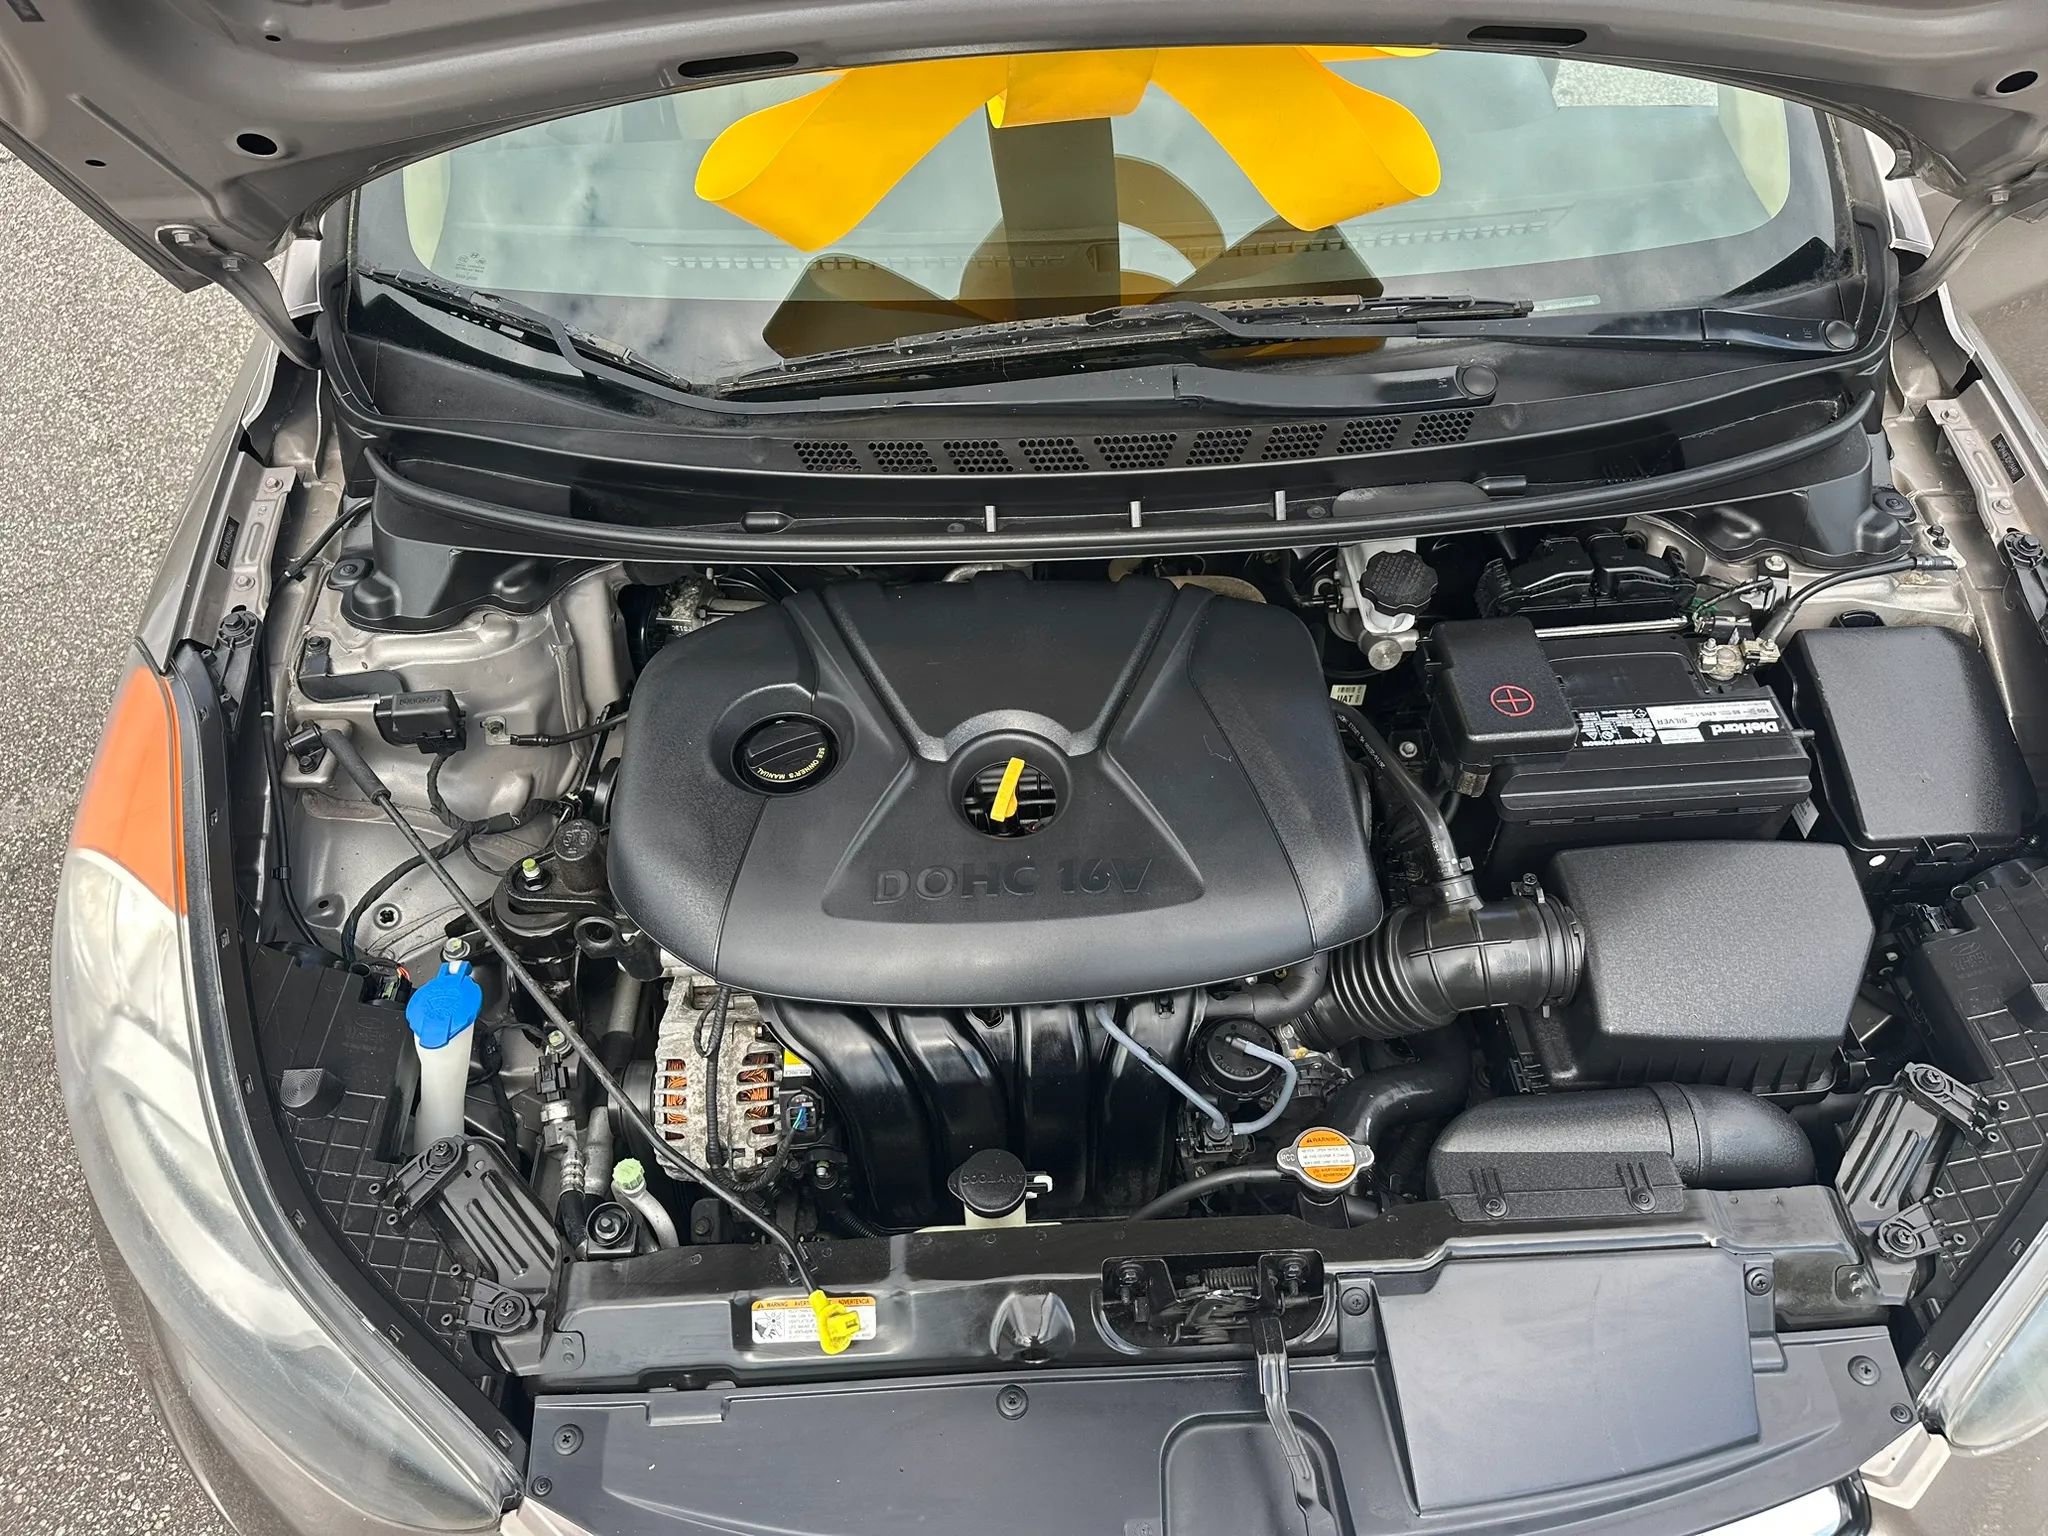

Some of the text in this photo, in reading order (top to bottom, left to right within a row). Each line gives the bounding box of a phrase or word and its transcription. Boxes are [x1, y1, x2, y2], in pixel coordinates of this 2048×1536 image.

[1656, 717, 1688, 726] SILVER
[1709, 720, 1779, 737] DieHard
[756, 747, 825, 780] SEE OWNER'S MANUAL
[872, 857, 1153, 904] DOHC 16V
[961, 1174, 1025, 1185] COOLANT
